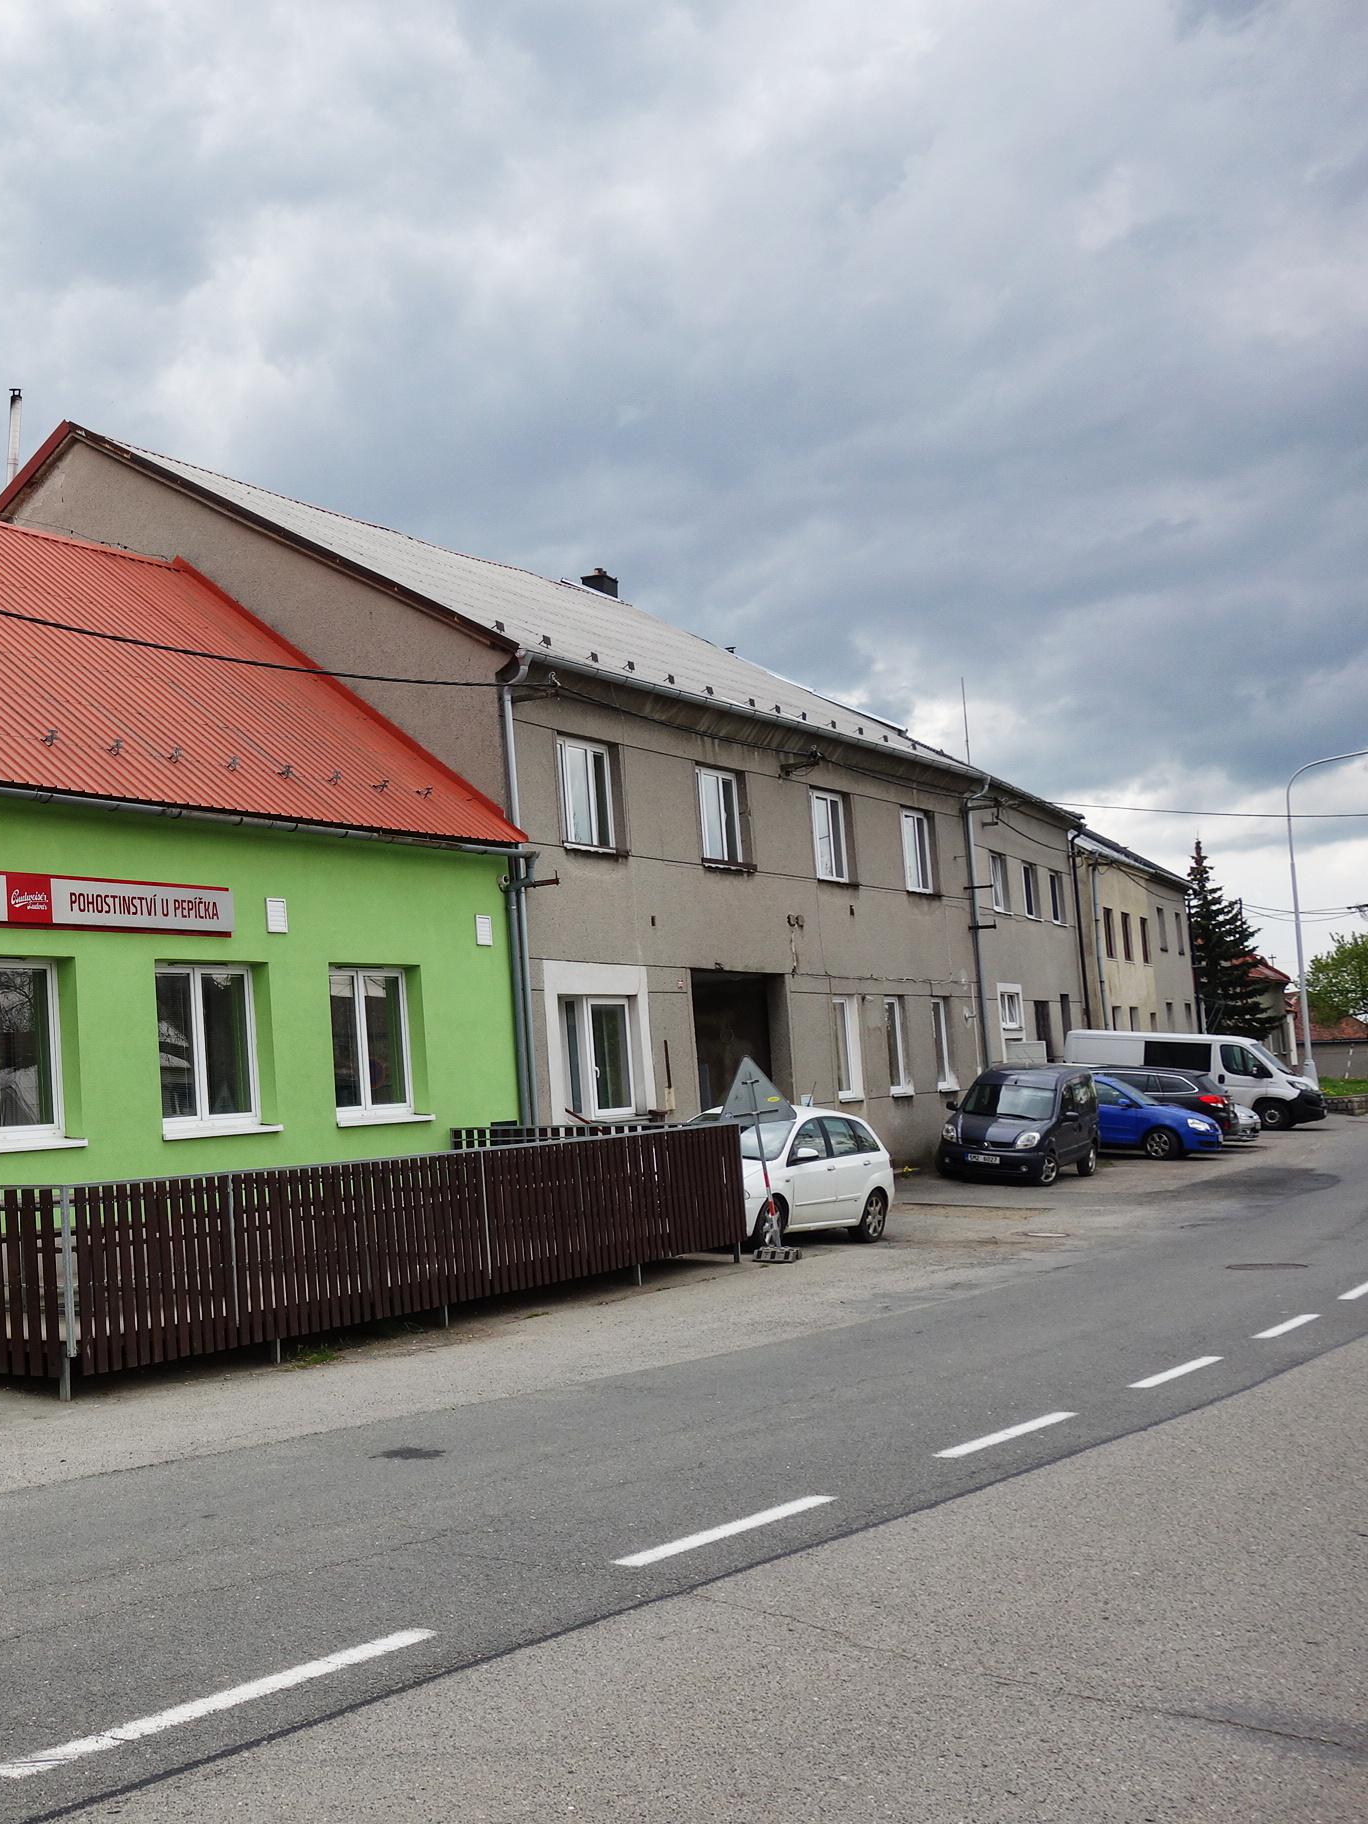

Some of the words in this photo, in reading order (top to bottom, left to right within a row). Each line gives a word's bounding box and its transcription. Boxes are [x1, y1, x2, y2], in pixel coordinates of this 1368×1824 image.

[69, 892, 157, 916] POHOSTINSTVÍ
[161, 898, 169, 917] U
[173, 897, 220, 920] PEPÍČKA
